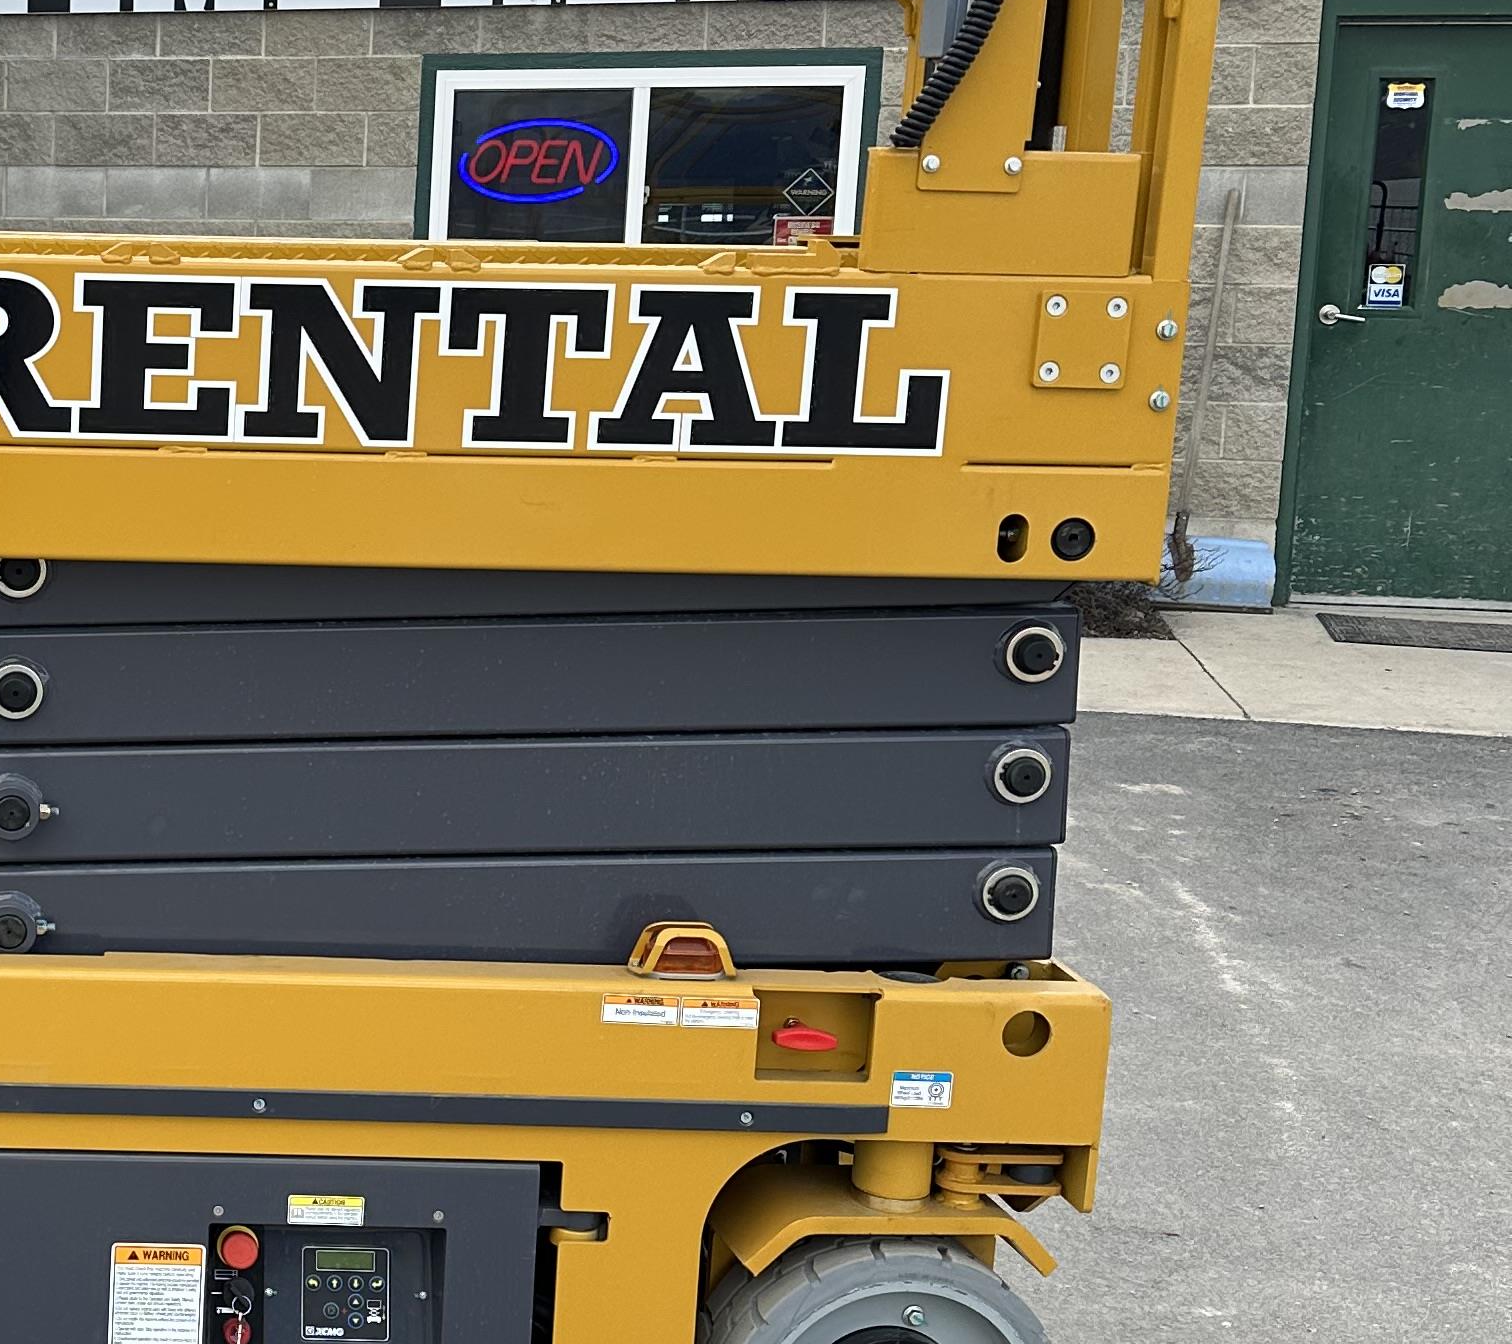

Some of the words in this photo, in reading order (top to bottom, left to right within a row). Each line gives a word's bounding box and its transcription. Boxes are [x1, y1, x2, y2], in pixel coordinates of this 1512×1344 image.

[469, 138, 605, 185] OPEN
[1373, 288, 1400, 299] VISA
[142, 1250, 190, 1261] WARNING
